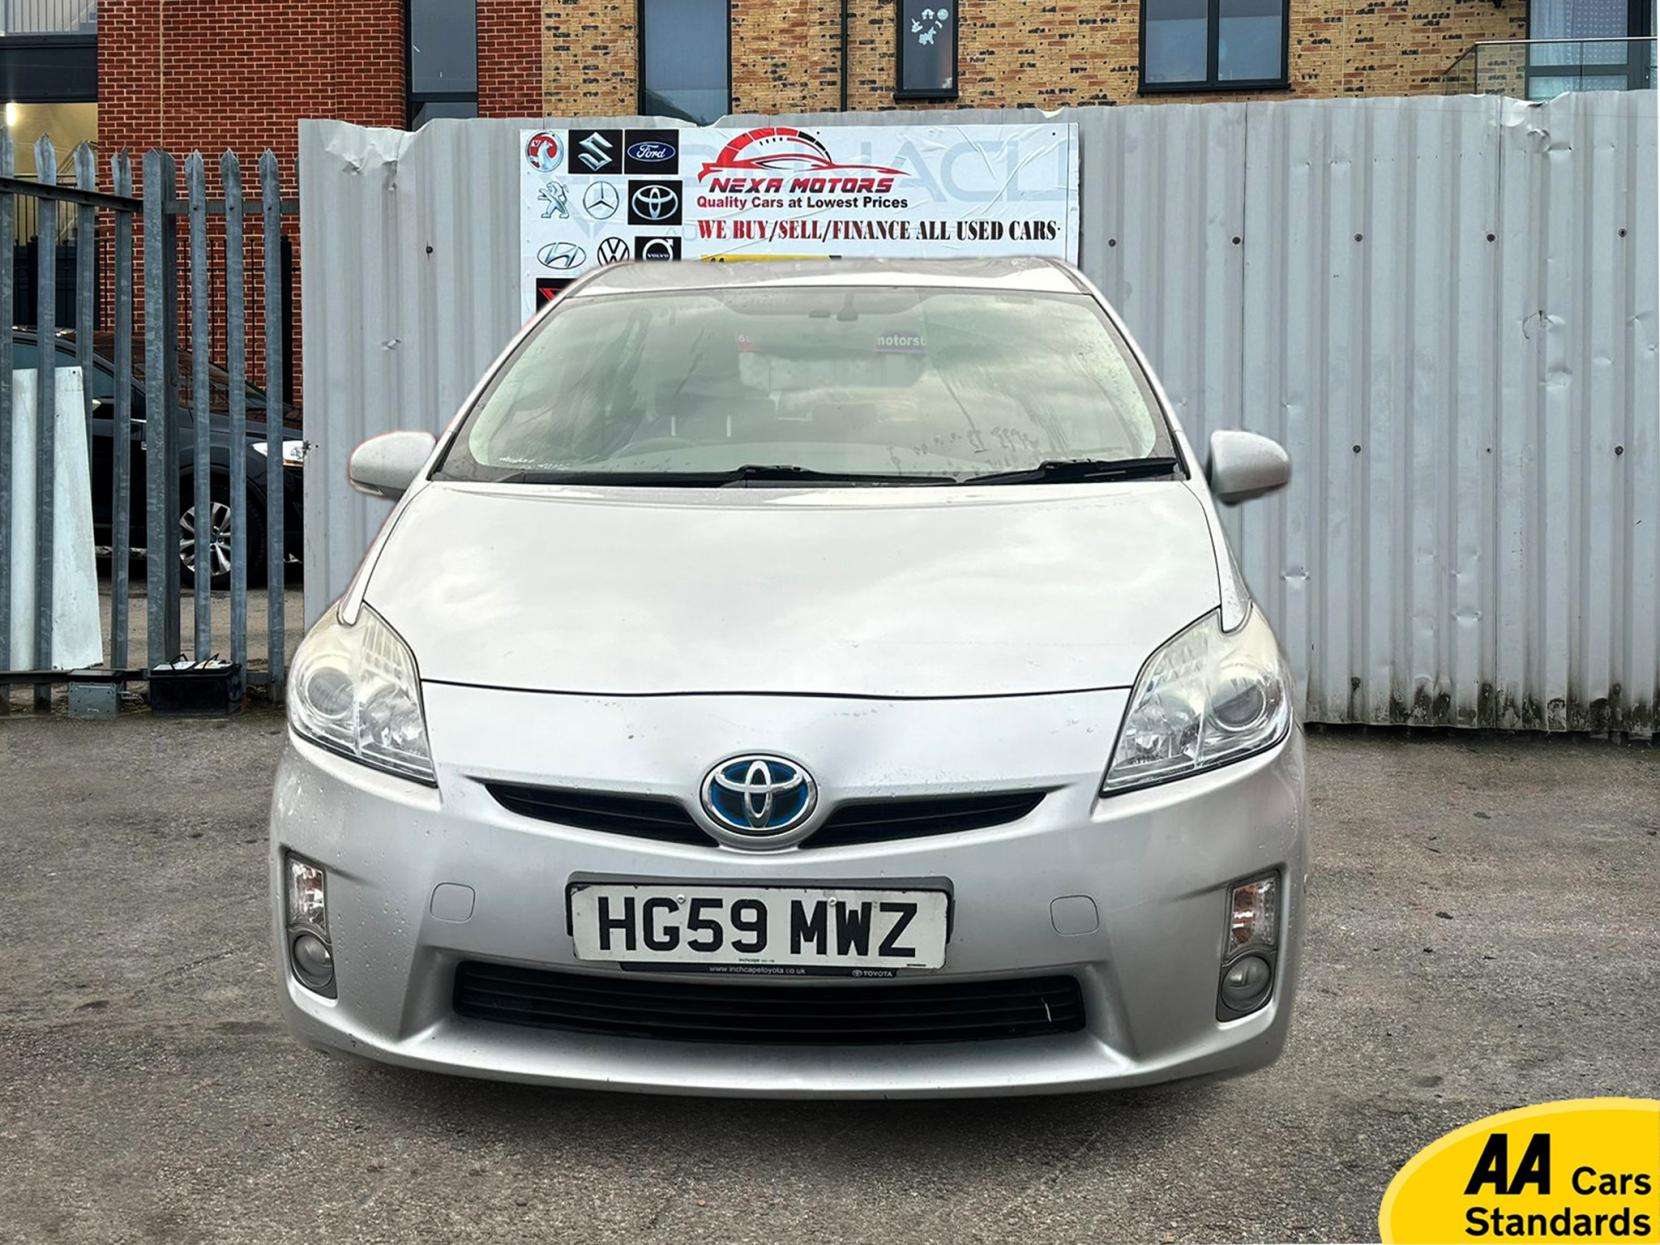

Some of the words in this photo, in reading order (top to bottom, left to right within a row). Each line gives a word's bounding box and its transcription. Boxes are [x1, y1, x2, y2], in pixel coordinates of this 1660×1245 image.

[636, 144, 665, 159] Ford
[708, 177, 784, 194] NEXA
[789, 177, 895, 194] MOTORS
[697, 196, 747, 209] Quality
[751, 196, 784, 208] Cars
[788, 197, 802, 208] at
[807, 196, 858, 208] Lowest
[863, 196, 908, 208] Prices
[697, 219, 727, 240] WE
[916, 220, 950, 240] ALL
[957, 220, 1004, 240] USED
[1009, 220, 1057, 240] CARS
[598, 896, 767, 954] HG59
[790, 900, 918, 958] MWZ
